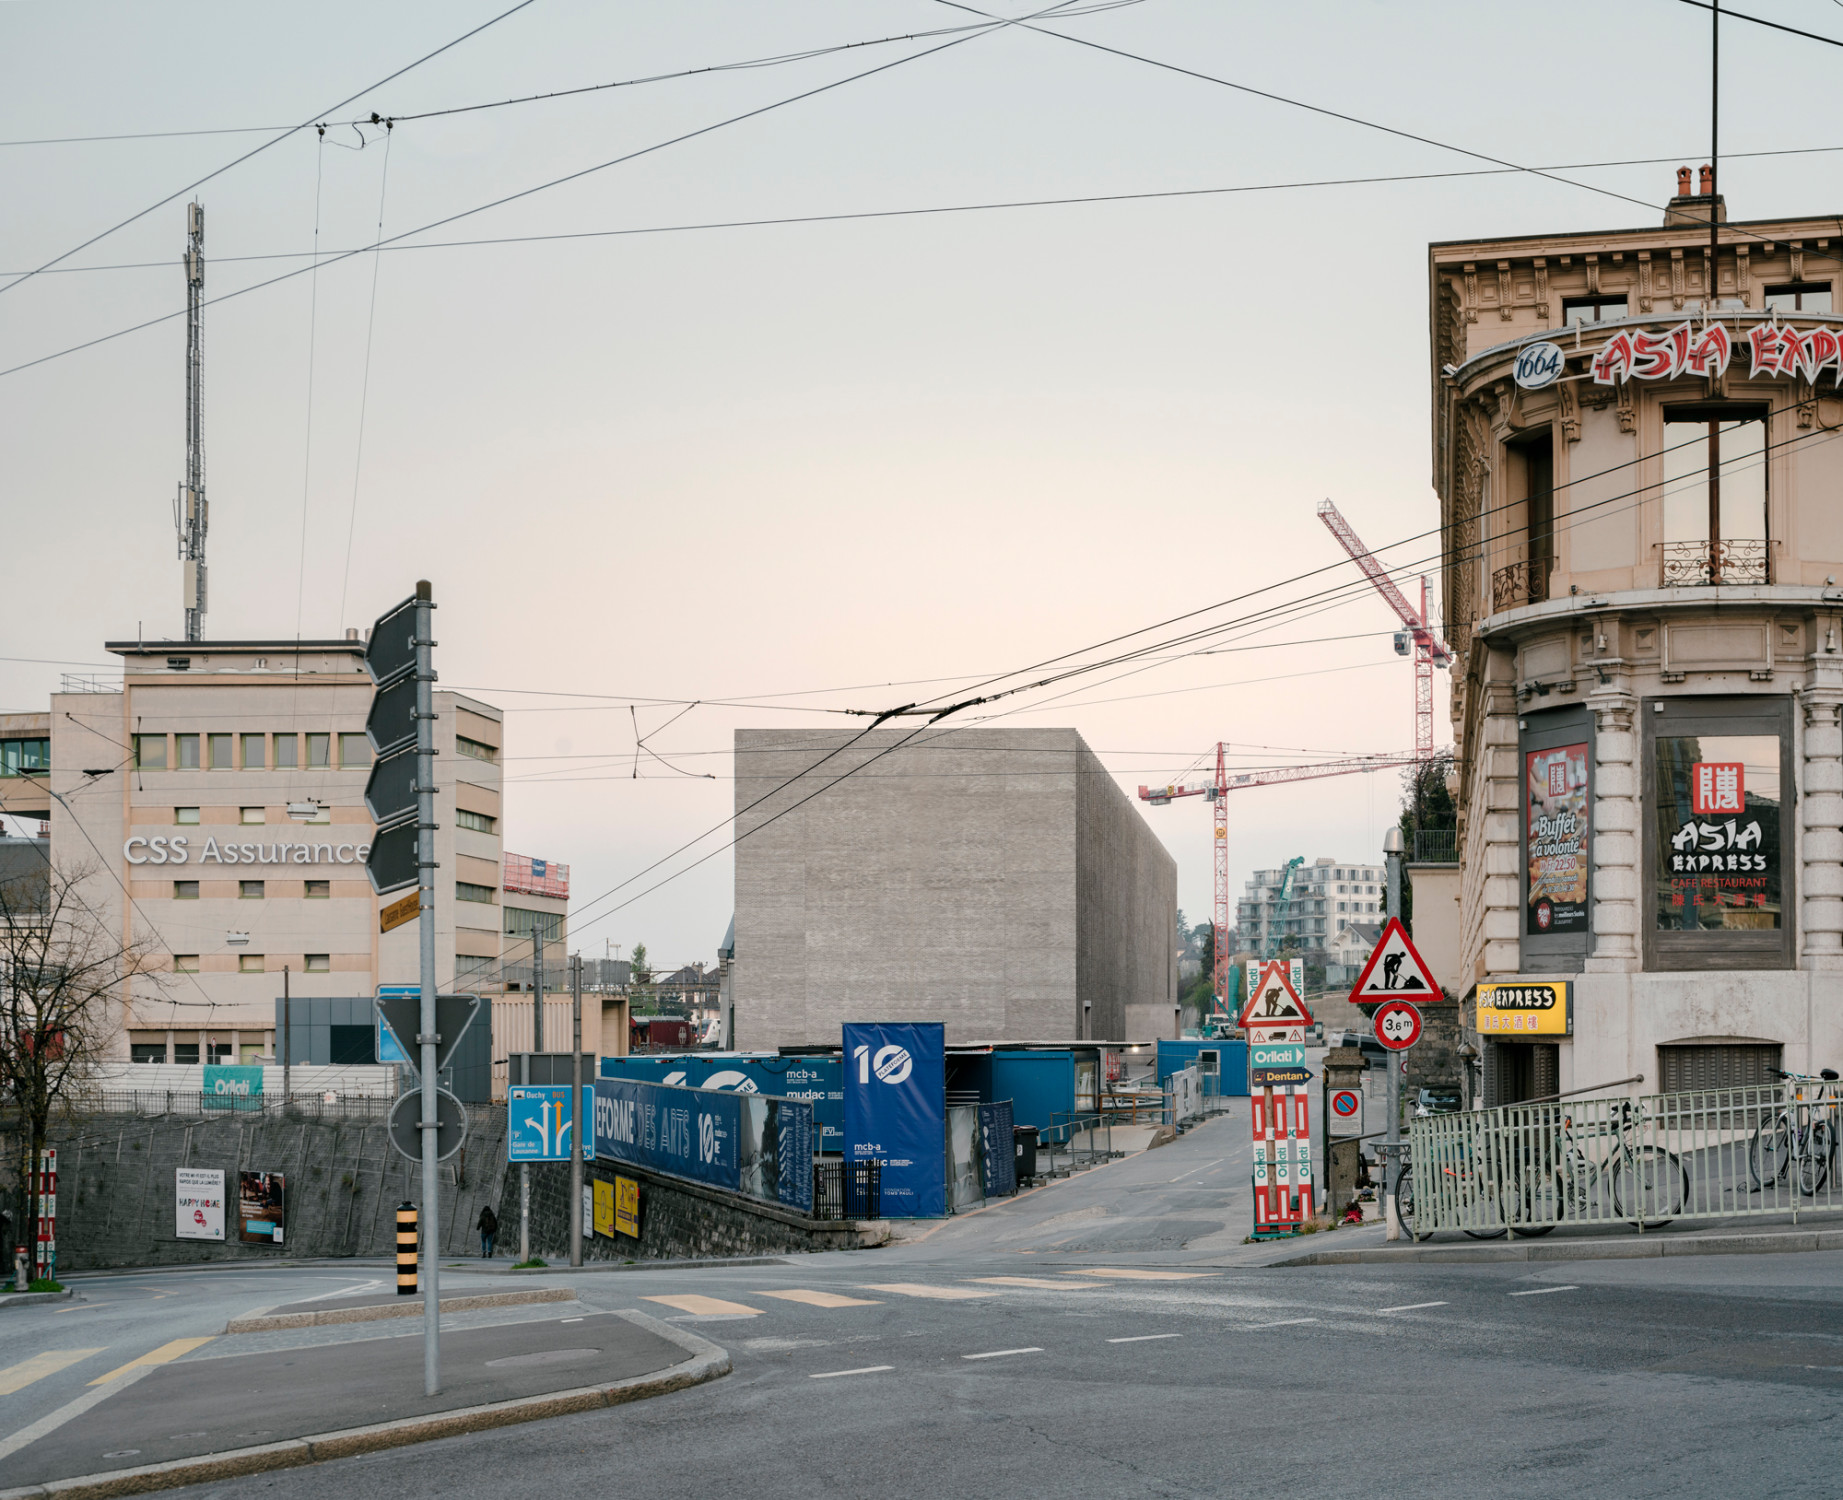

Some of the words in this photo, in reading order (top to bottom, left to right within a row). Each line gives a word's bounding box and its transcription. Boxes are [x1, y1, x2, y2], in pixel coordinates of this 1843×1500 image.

[1517, 348, 1560, 380] 1664
[1590, 320, 1732, 386] ASIA
[1747, 320, 1843, 389] EXP
[1538, 812, 1577, 841] Buffet
[1671, 818, 1762, 851] ASIA
[123, 836, 189, 864] CSS
[199, 836, 371, 864] Assurance
[1536, 840, 1543, 857] à
[1544, 837, 1580, 856] volonté
[1672, 853, 1767, 871] EXPRESS
[1671, 879, 1698, 888] CAFE
[1701, 878, 1767, 887] RESTAURANT
[1672, 893, 1767, 906] 陳氏大酒樓
[1291, 966, 1303, 997] Orllati
[1495, 988, 1554, 1008] EXPRESS
[1403, 1020, 1413, 1028] m
[854, 1044, 913, 1085] 10
[878, 1051, 908, 1077] PLATEFORME
[1254, 1049, 1293, 1064] Orllati
[786, 1069, 817, 1079] mcb-a
[1266, 1071, 1304, 1081] Dentan
[526, 1091, 546, 1100] Ouchy
[552, 1091, 565, 1099] BUS
[786, 1089, 825, 1100] mudac
[854, 1142, 881, 1151] mcb-a
[1256, 1148, 1267, 1179] Orati
